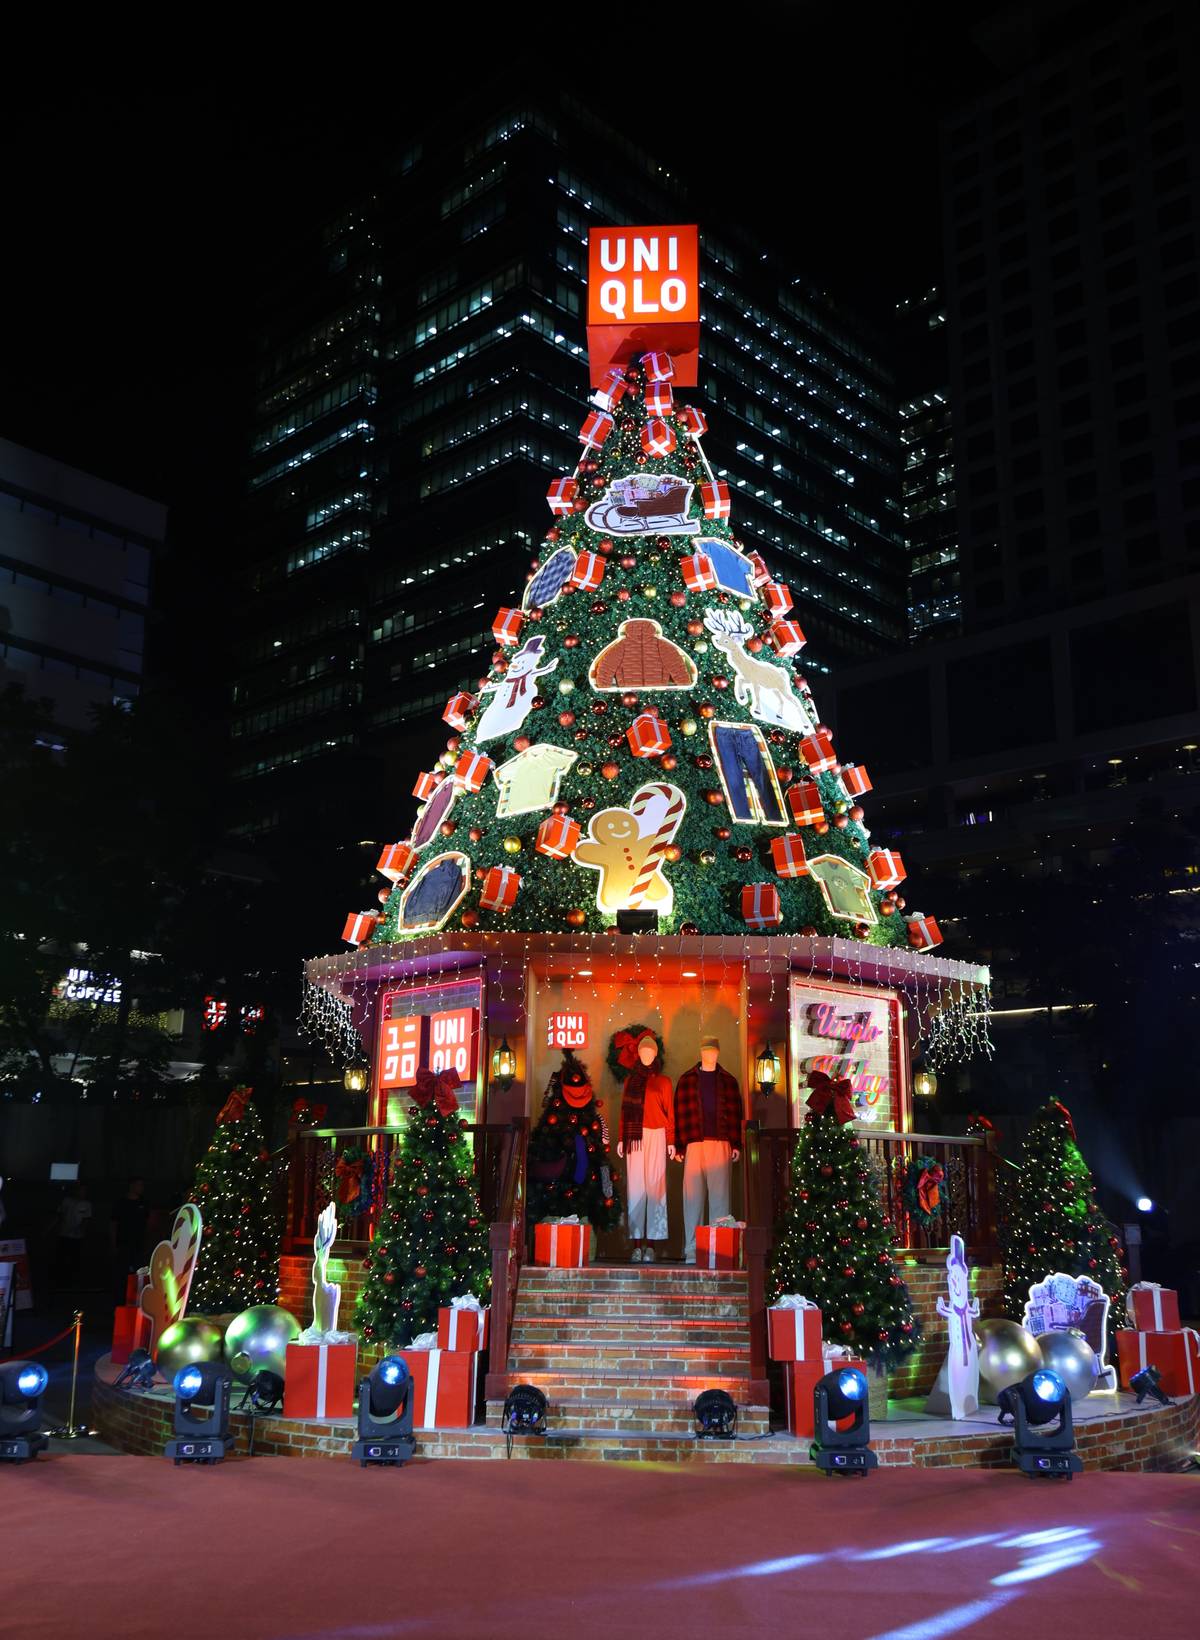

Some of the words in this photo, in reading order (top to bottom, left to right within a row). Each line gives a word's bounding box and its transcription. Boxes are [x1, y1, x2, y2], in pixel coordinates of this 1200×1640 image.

[600, 237, 678, 272] UNI
[600, 278, 687, 320] QLO
[66, 985, 122, 1003] COFFEE
[433, 1017, 465, 1046] UNI
[556, 1015, 583, 1030] UNI
[386, 1024, 416, 1052] ユニ
[556, 1030, 586, 1047] QLO
[383, 1053, 416, 1080] クロ
